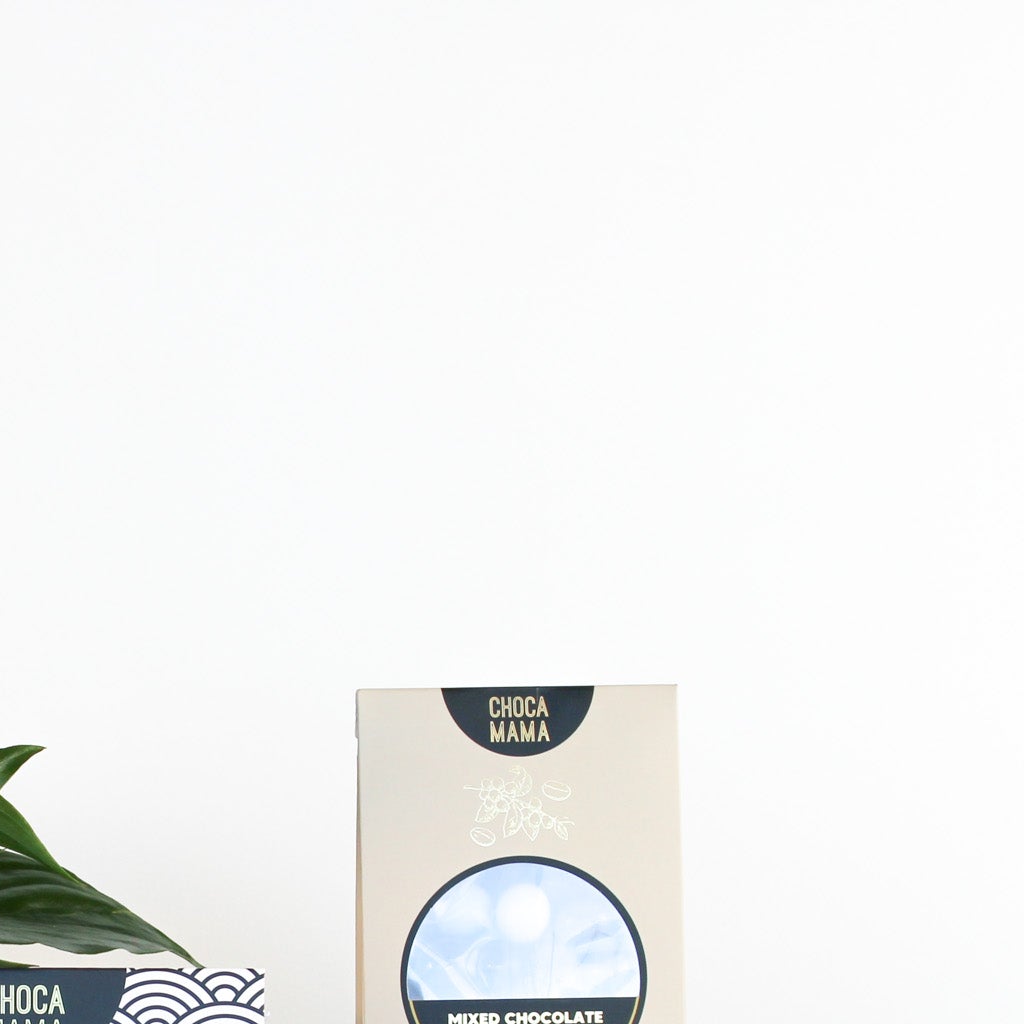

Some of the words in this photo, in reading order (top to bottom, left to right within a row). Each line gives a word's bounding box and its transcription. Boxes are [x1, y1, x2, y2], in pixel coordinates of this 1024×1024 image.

[489, 696, 549, 718] CHOCA
[489, 720, 550, 743] MAMA
[504, 1011, 604, 1024] CHOCOLATE
